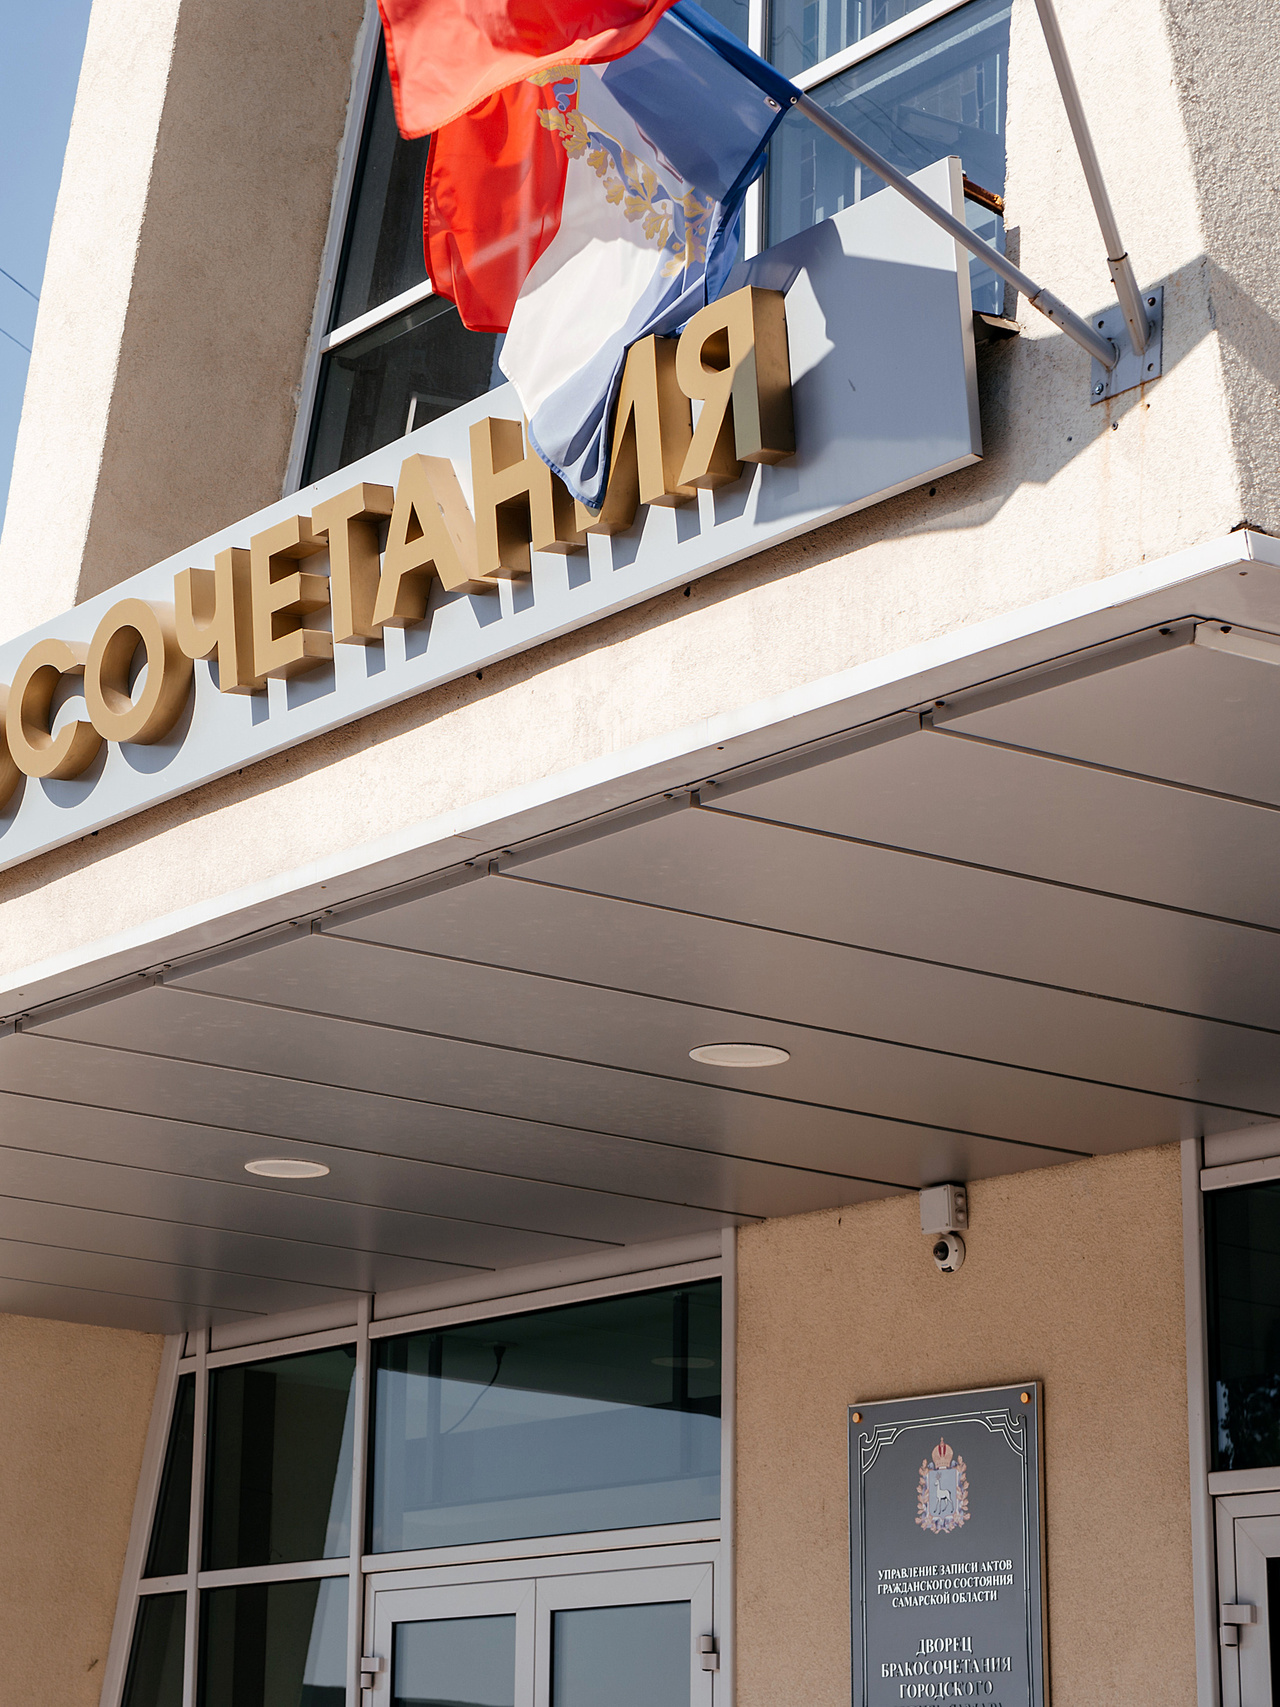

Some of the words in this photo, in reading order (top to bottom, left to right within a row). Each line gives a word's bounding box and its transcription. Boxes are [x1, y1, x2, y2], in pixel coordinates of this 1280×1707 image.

[877, 1565, 939, 1581] УПРАВЛЕНИЕ
[940, 1561, 979, 1576] ЗАПИСИ
[980, 1559, 1013, 1572] АКТОВ
[877, 1578, 952, 1595] ГРАЖДАНСКОГО
[953, 1574, 1014, 1589] СОСТОЯНИЯ
[892, 1591, 950, 1608] САМАРСКОЙ
[951, 1590, 998, 1604] ОБЛАСТИ
[915, 1636, 973, 1656] ДВОРЕЦ
[881, 1656, 1013, 1678] БРАКОСОЧЕТАНИЯ
[899, 1680, 994, 1700] ГОРОДСКОГО
